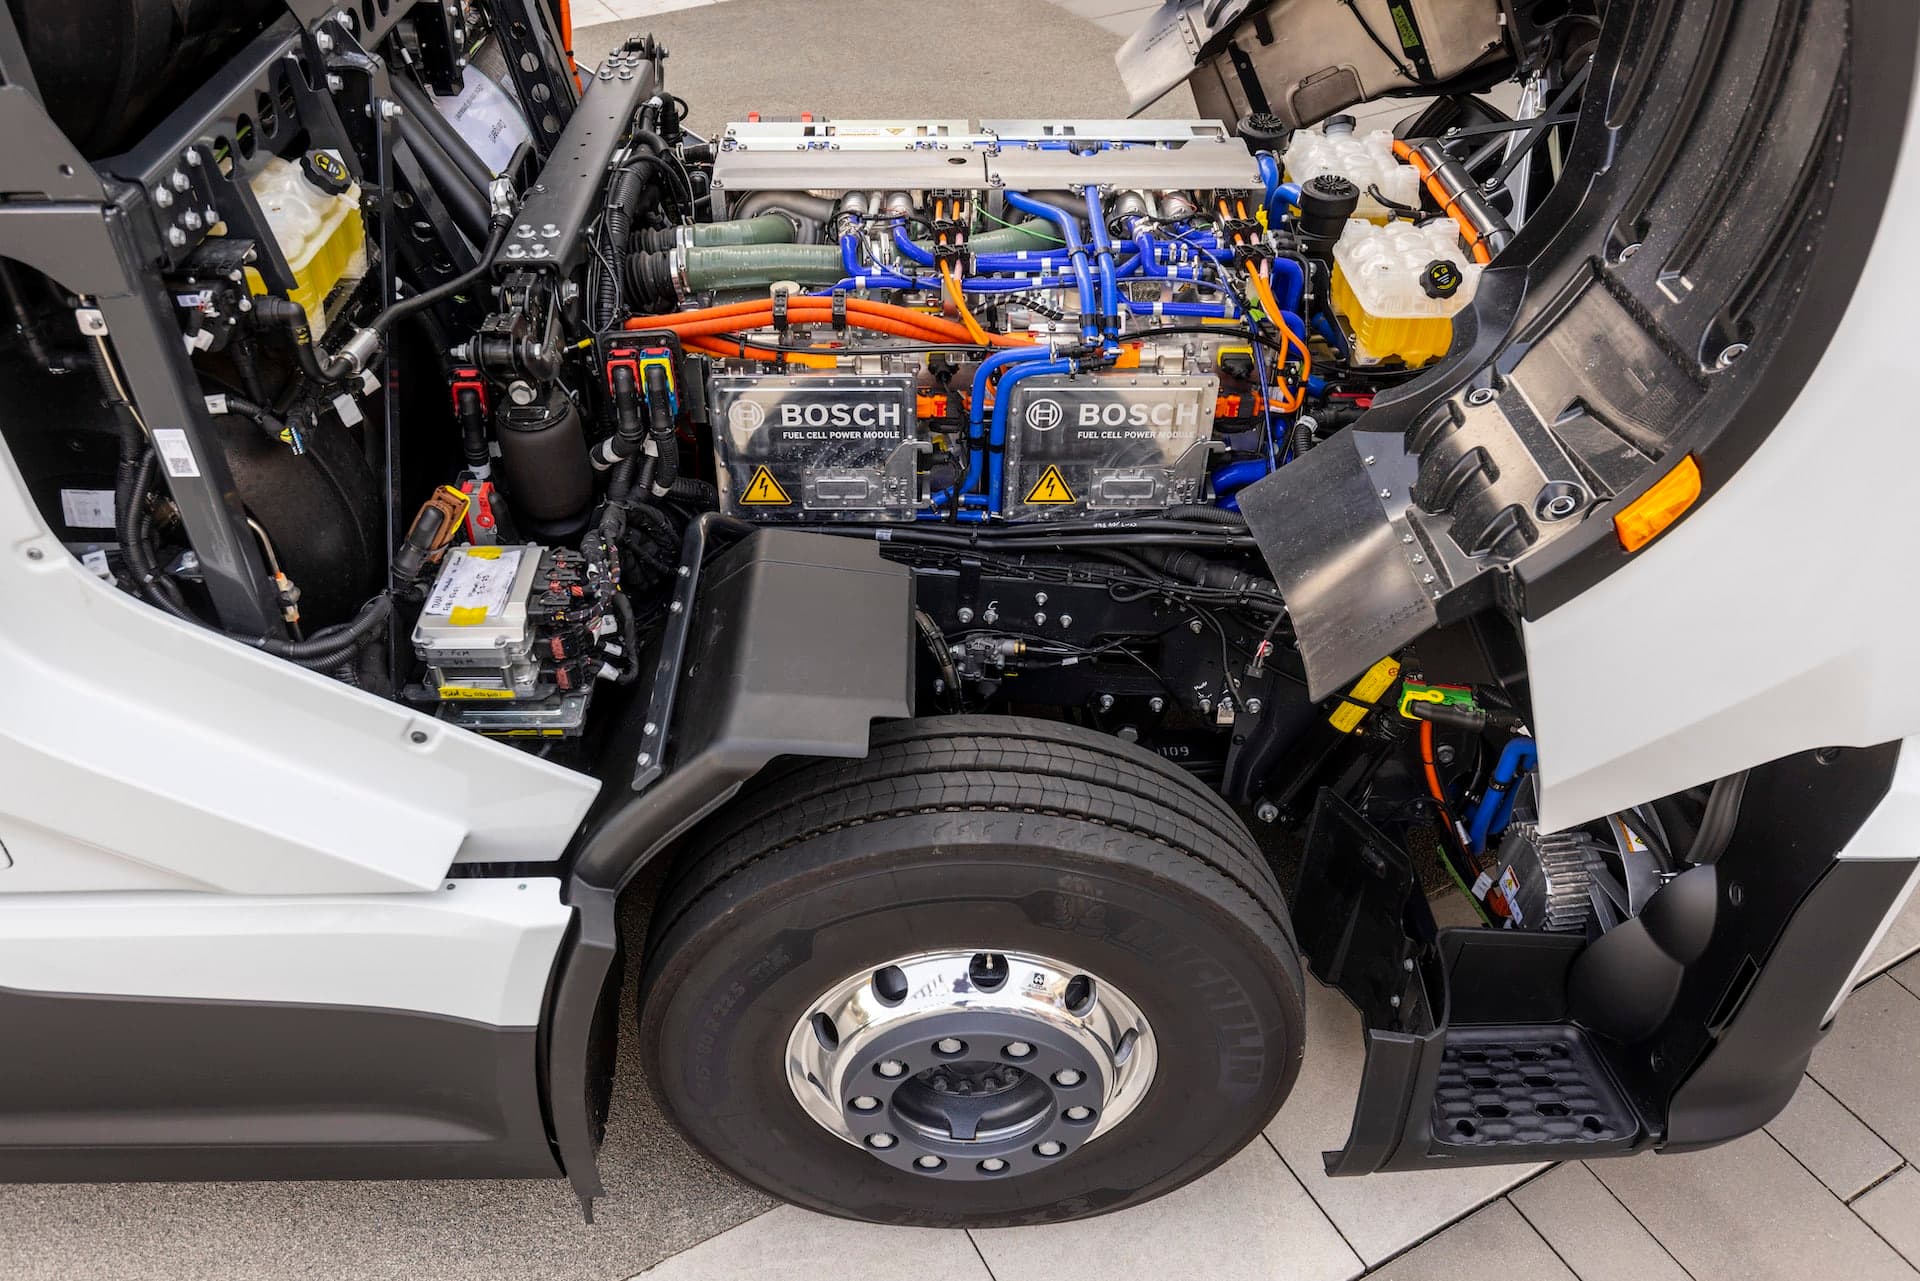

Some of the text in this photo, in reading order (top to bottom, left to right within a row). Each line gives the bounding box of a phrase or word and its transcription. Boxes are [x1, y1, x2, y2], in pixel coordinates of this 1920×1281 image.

[780, 403, 900, 426] BOSCH
[1078, 403, 1199, 426] BOSCH
[783, 431, 900, 439] FUEL CELL POWER MODULE
[1077, 431, 1195, 439] FUEL CELL POWER MODULE
